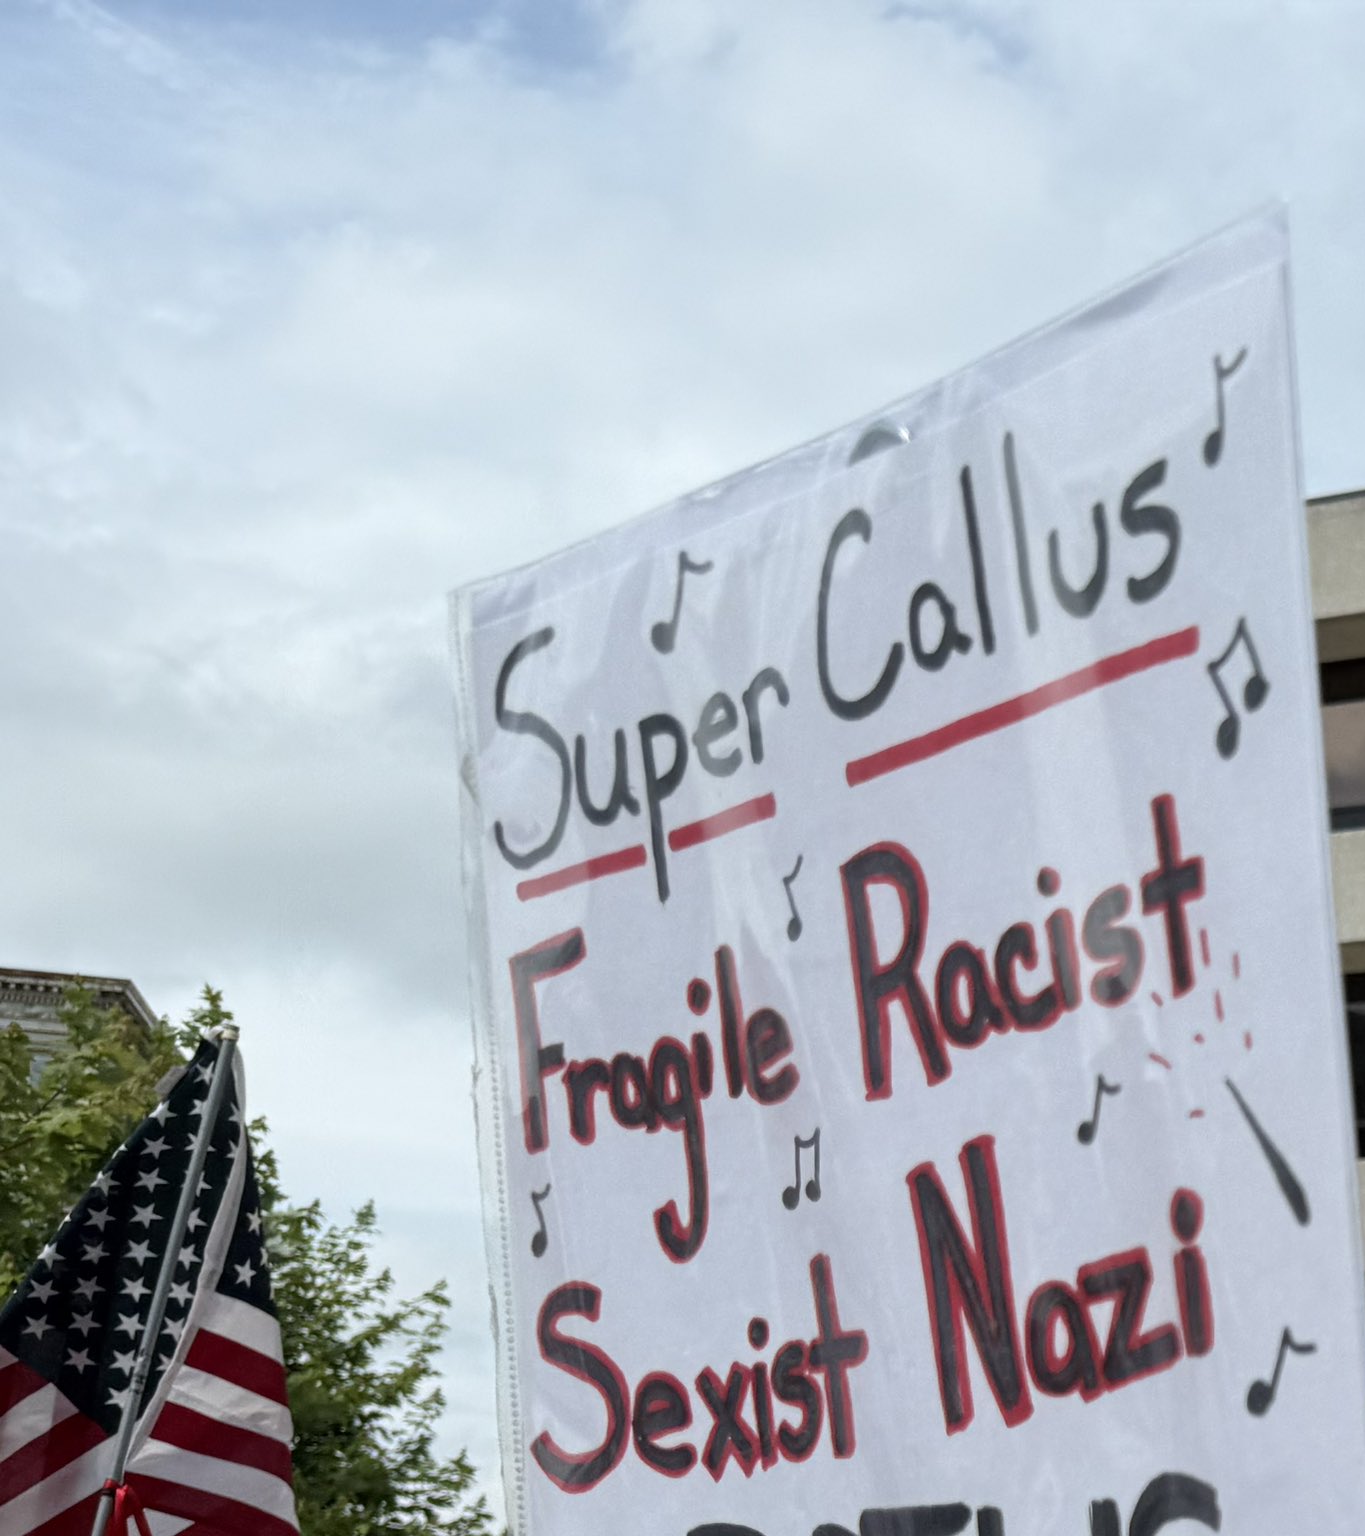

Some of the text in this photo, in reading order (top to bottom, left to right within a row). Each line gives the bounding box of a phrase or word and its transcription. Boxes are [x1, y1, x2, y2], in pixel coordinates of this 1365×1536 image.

[493, 432, 1181, 903] Super Callus
[509, 794, 1204, 1264] Fragile Racist
[530, 1134, 1214, 1494] Sexist Nazi
